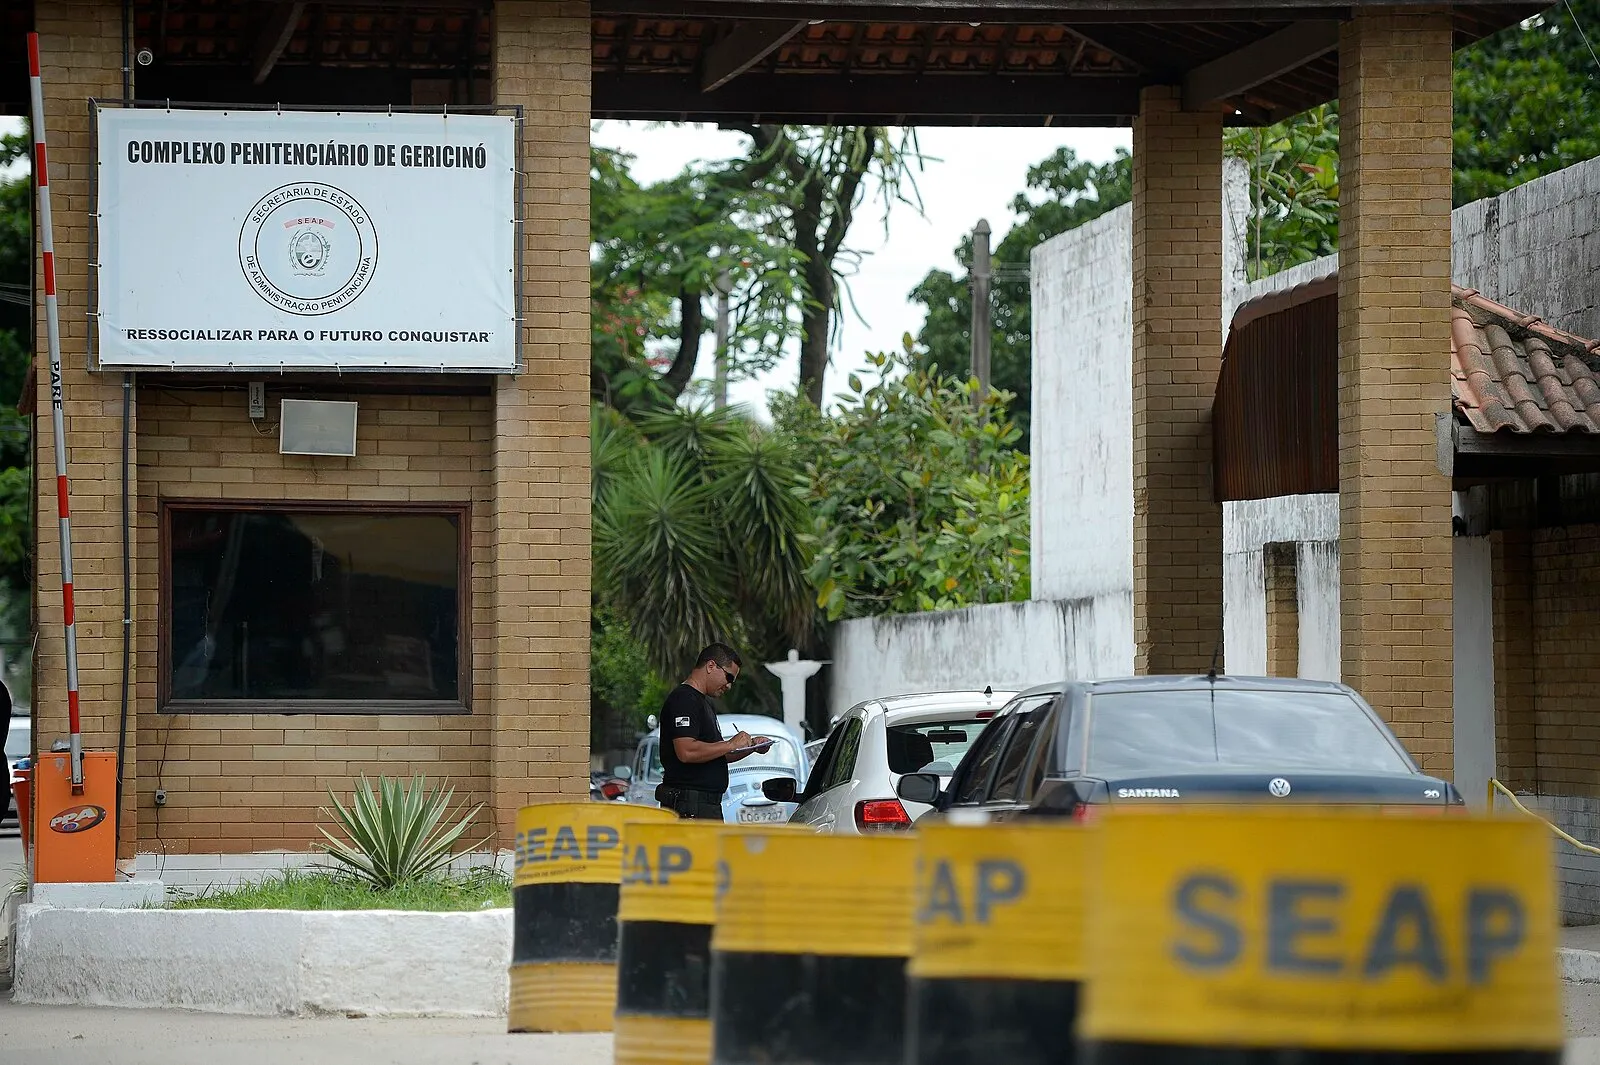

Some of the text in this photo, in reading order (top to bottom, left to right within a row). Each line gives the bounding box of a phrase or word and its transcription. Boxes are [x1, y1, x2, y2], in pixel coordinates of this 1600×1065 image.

[127, 140, 487, 168] COMPLEXO PENITENCIÁRIO DE GERICINÓ
[252, 187, 365, 225] SECRETARIA DE ESTADO
[297, 217, 324, 225] SEAP
[246, 255, 371, 312] DE ADMINISTRAÇÃO PENITENCIÁRIA
[258, 330, 299, 341] PARA
[303, 330, 315, 341] O
[320, 330, 383, 342] FUTURO
[51, 361, 62, 410] PARE
[1118, 788, 1180, 798] SANTANA
[50, 807, 97, 828] PPA
[623, 845, 692, 886] AP
[915, 858, 1027, 925] AP
[1168, 868, 1528, 987] SEAP
